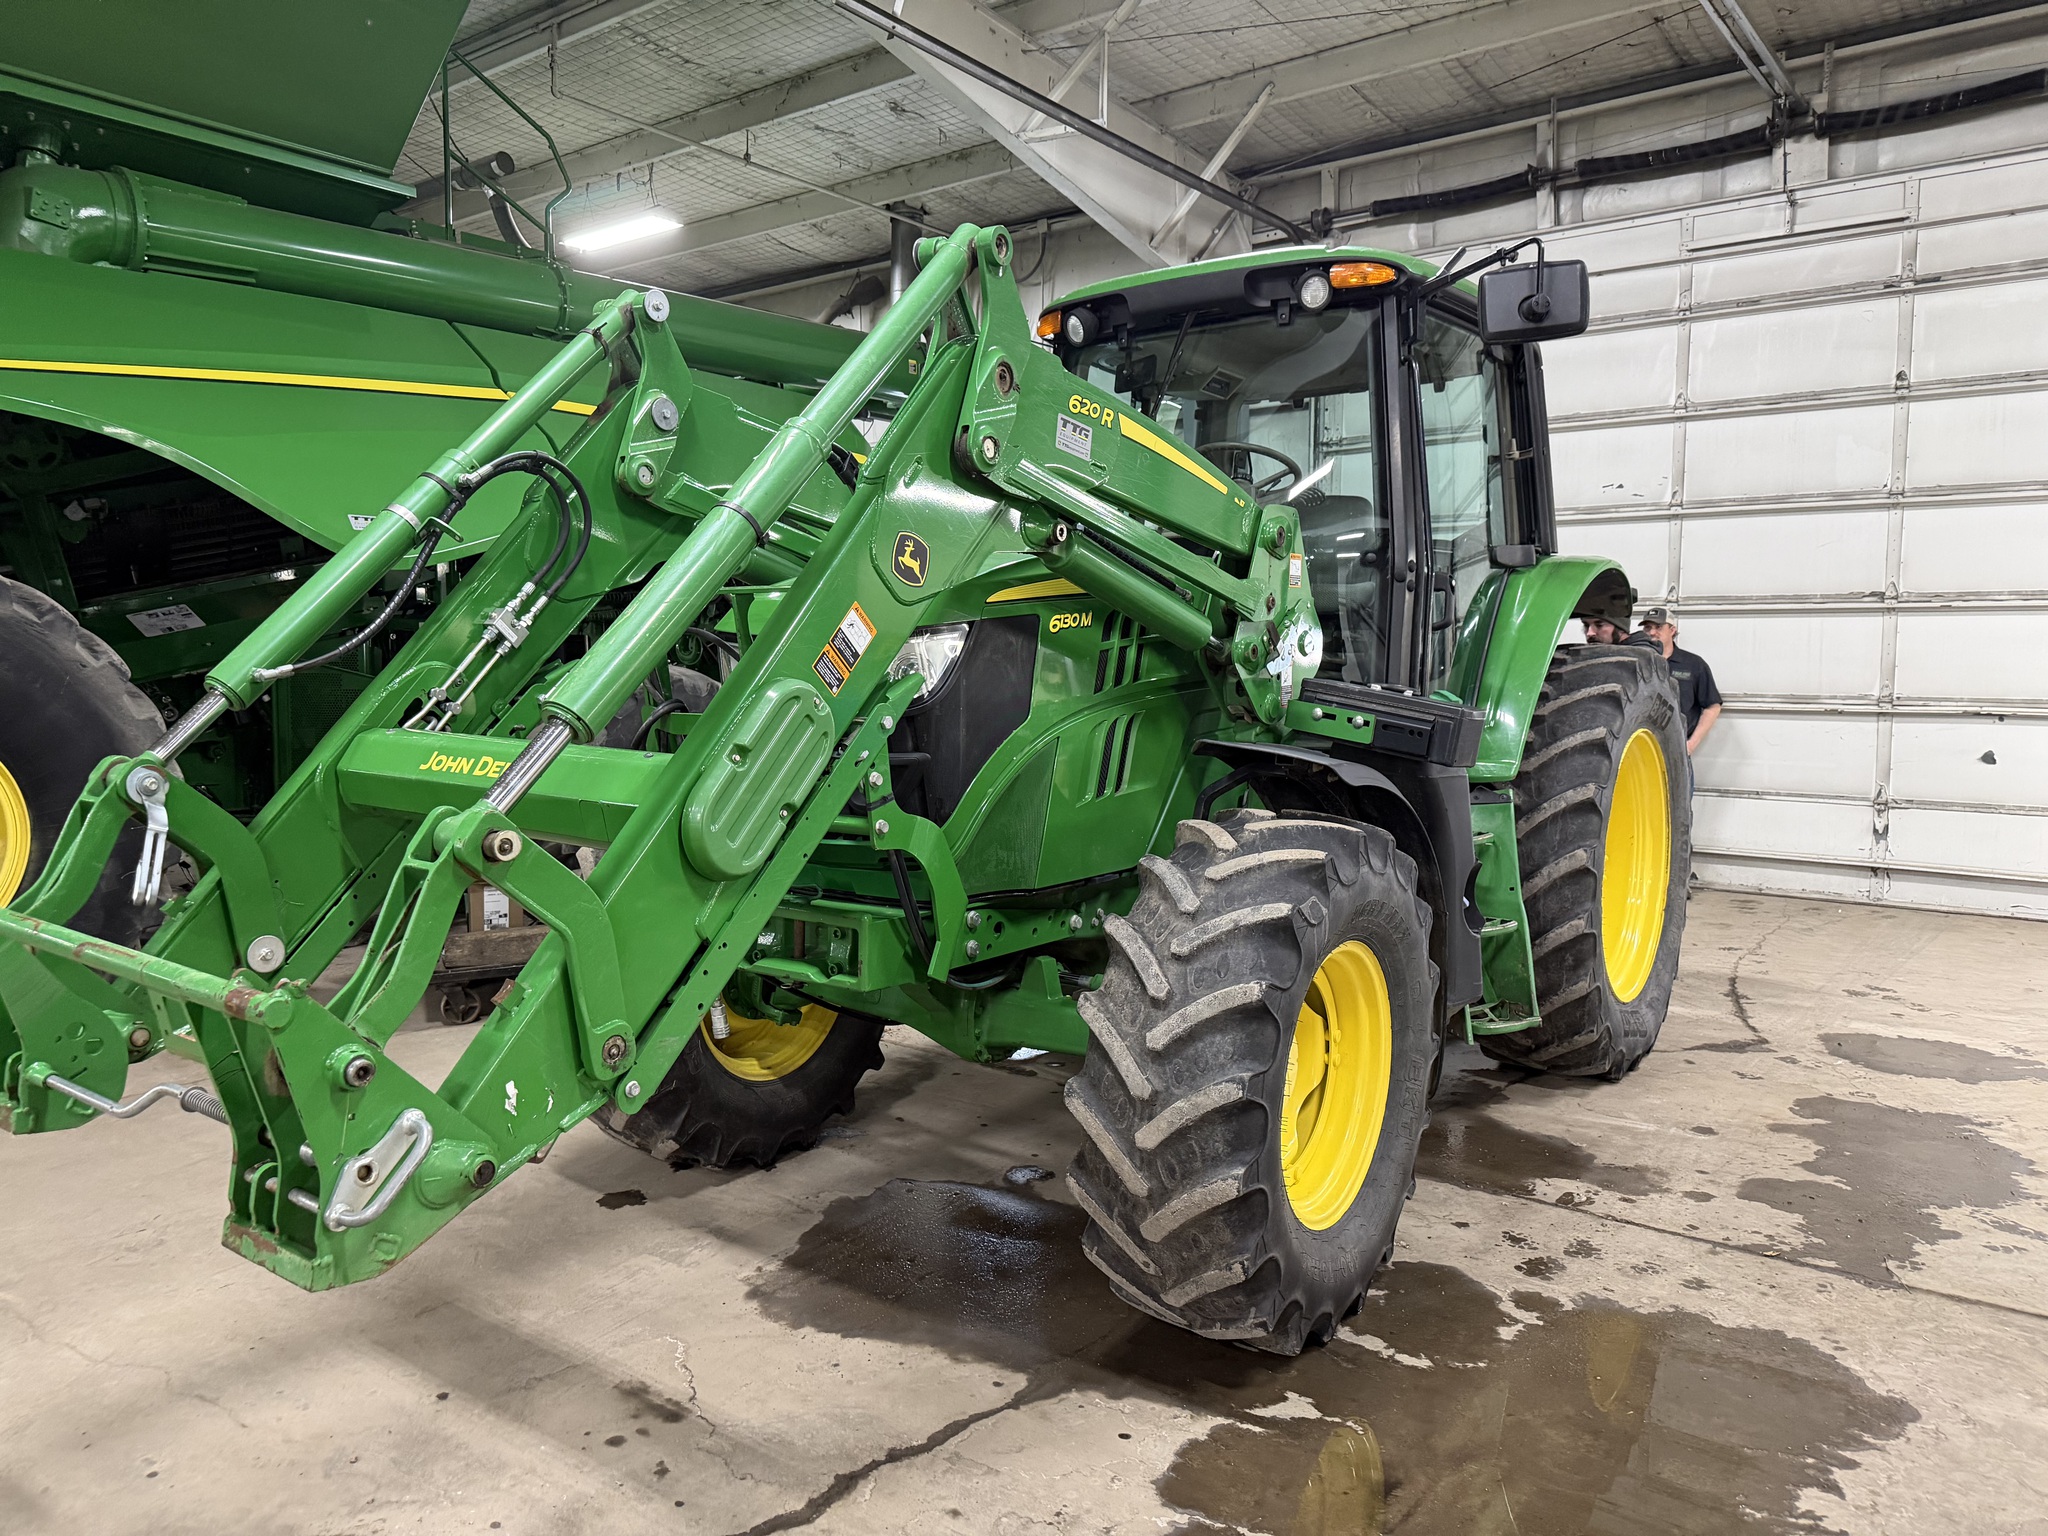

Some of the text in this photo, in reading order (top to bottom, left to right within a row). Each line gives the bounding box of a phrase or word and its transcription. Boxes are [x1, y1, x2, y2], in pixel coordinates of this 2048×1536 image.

[1068, 394, 1114, 429] 620 R
[1059, 432, 1088, 447] EQUIPMENT
[1060, 417, 1090, 441] TTG
[858, 610, 874, 633] WARNING
[1049, 612, 1080, 634] 6130
[830, 655, 847, 677] WARNING
[1646, 692, 1675, 732] BKT
[419, 751, 475, 775] JOHN
